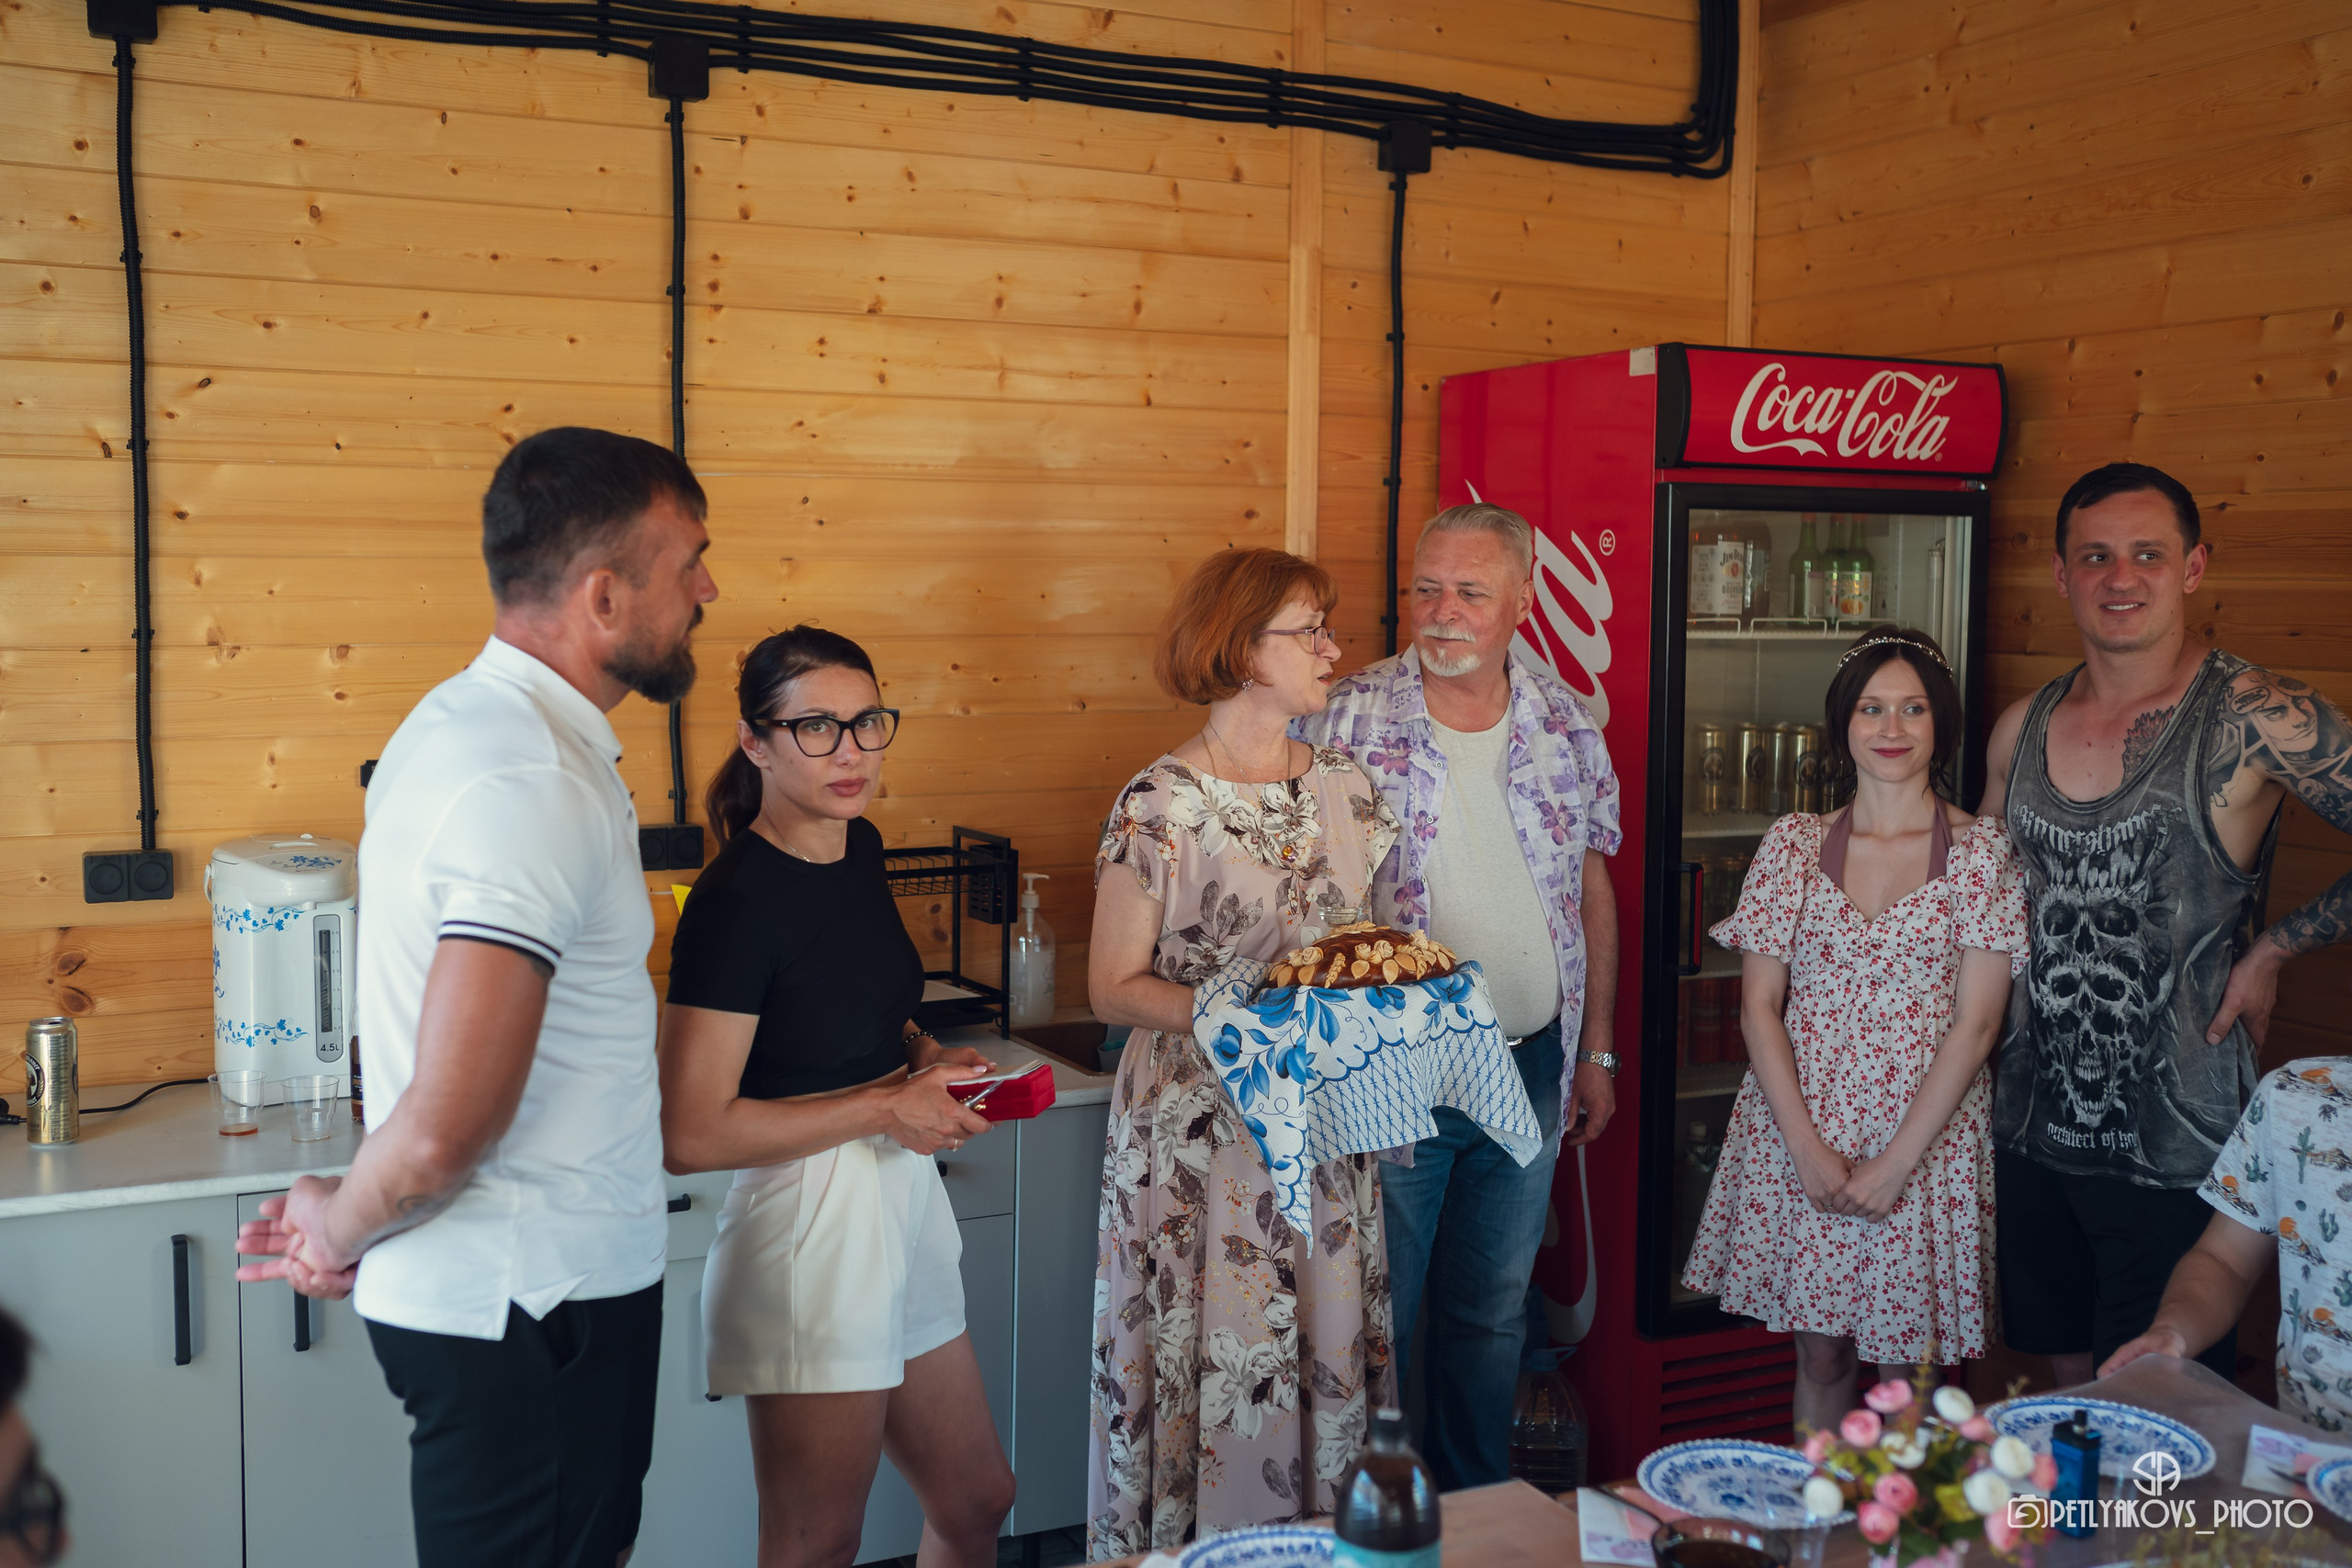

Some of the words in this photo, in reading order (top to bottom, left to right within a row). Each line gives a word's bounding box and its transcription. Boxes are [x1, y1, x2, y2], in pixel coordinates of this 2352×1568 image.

[1731, 363, 1959, 461] Coca-Cola
[320, 1043, 340, 1053] 4.5L
[2100, 1128, 2116, 1150] of
